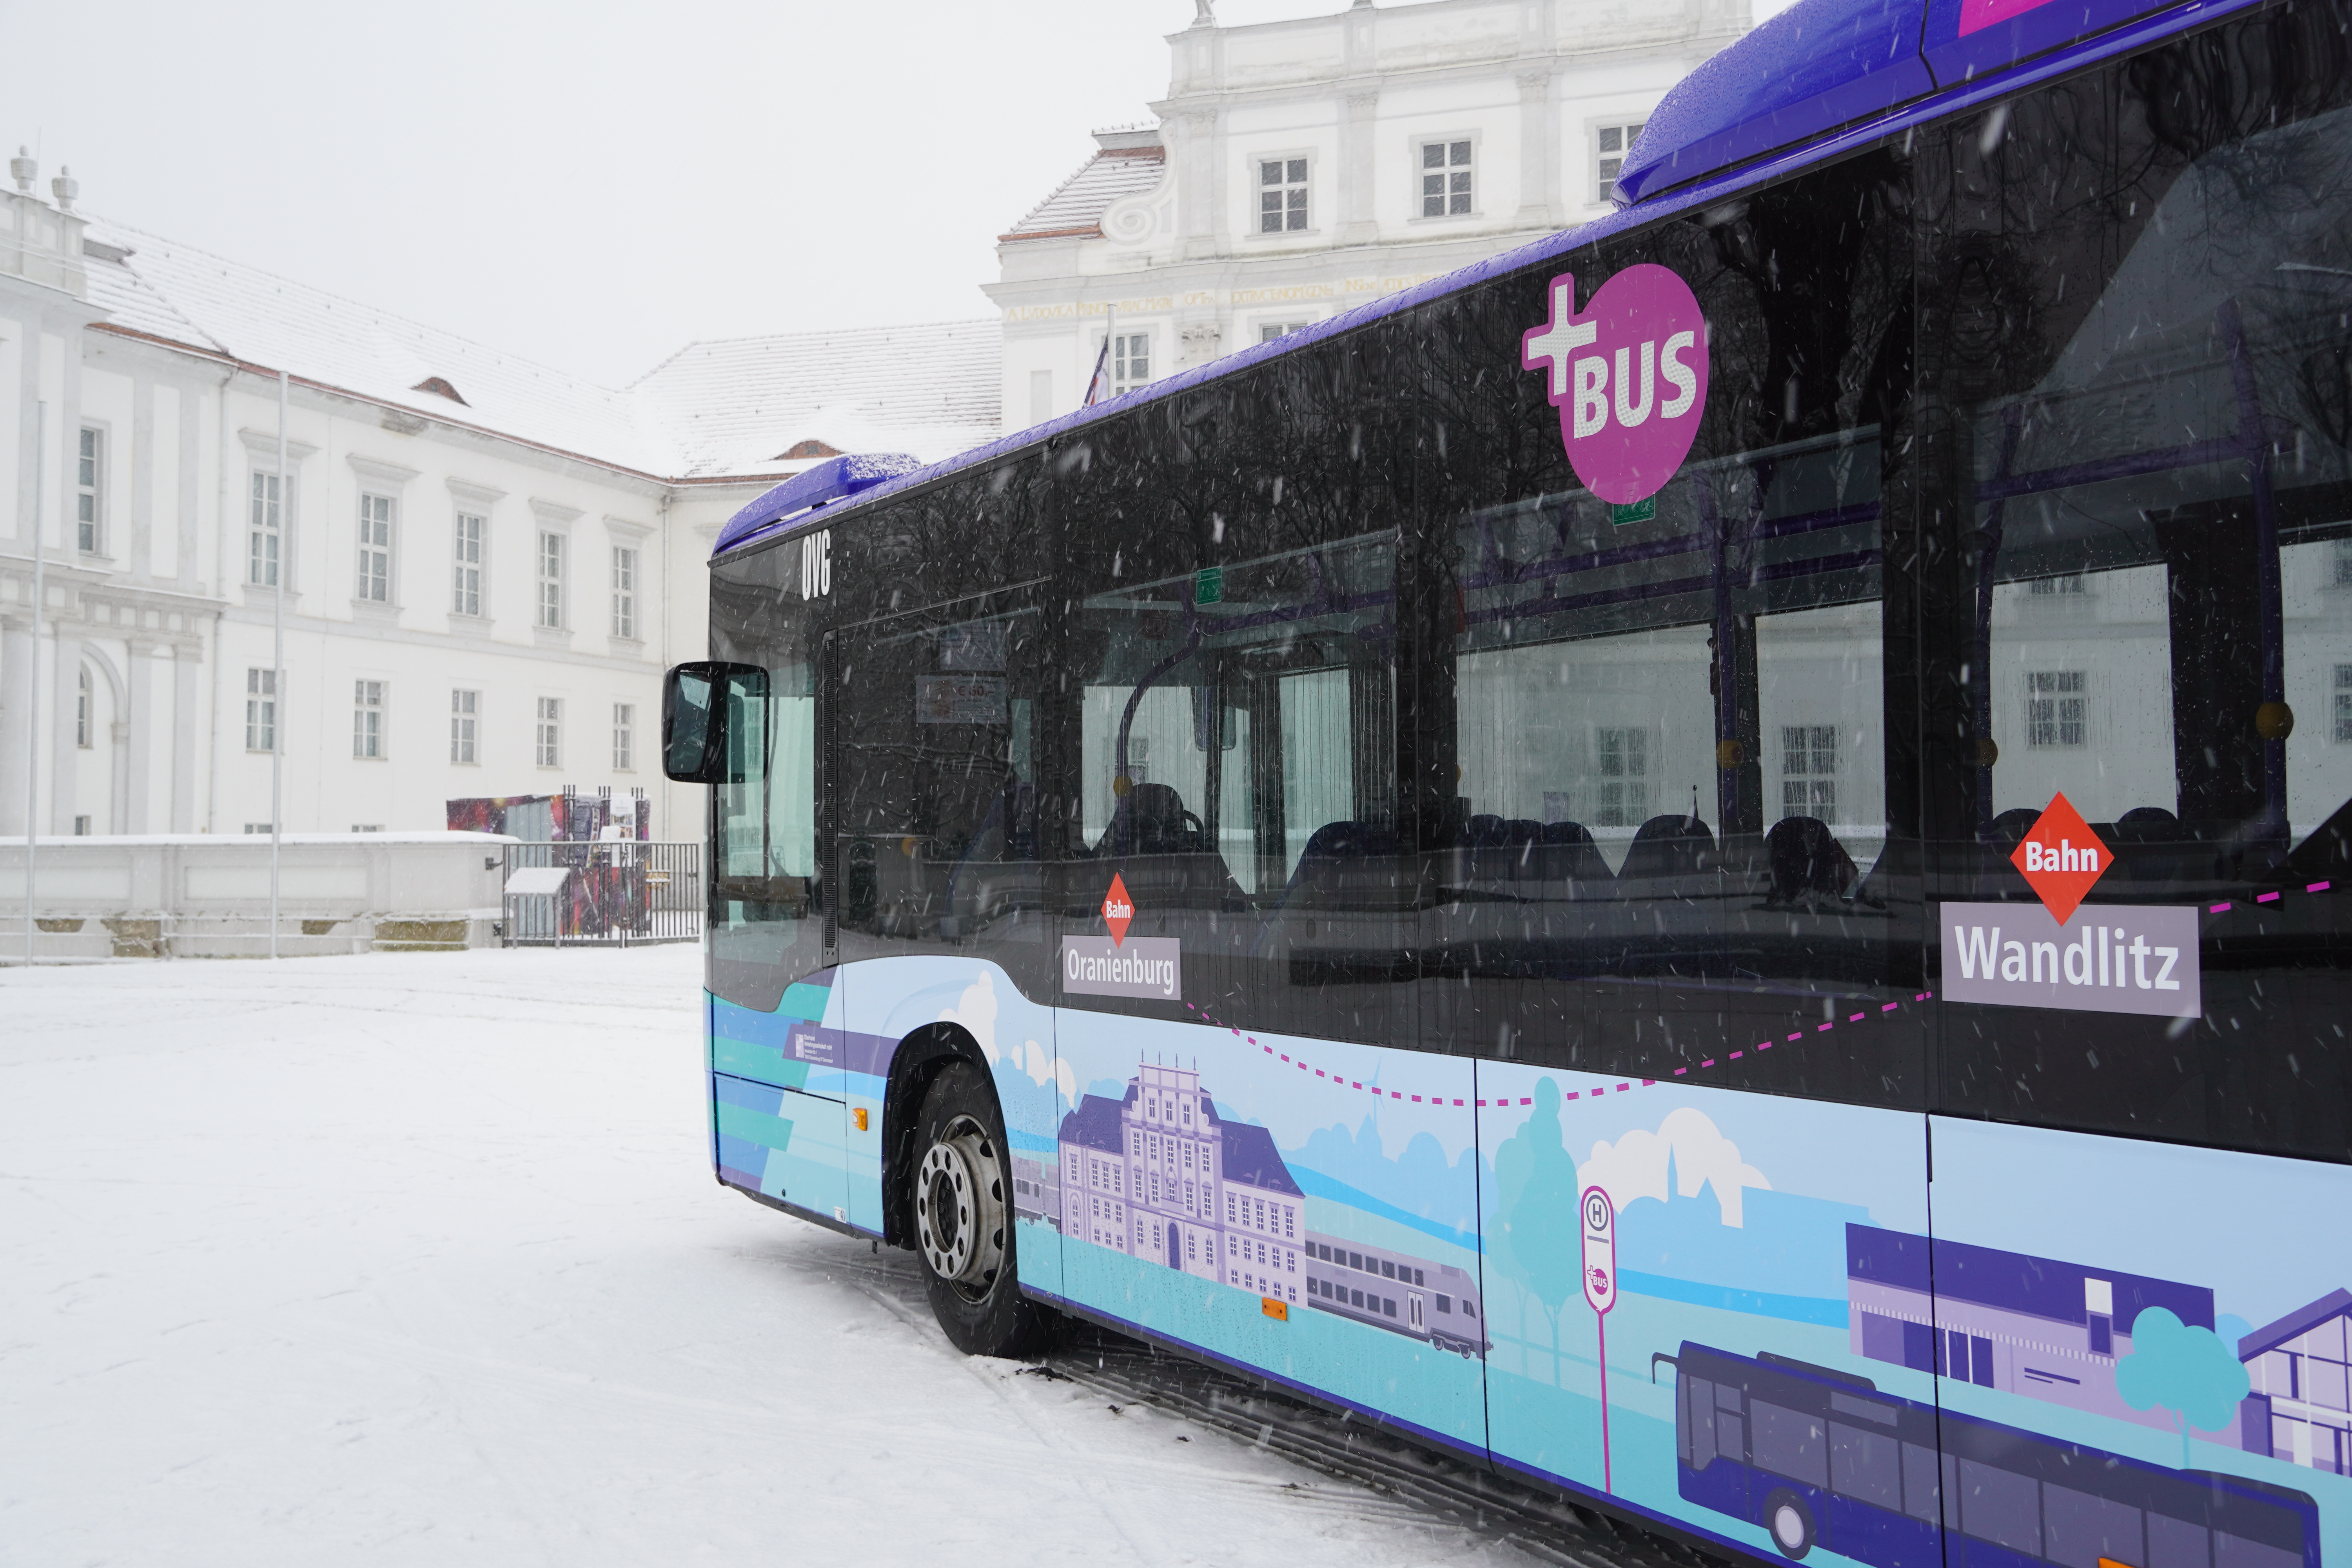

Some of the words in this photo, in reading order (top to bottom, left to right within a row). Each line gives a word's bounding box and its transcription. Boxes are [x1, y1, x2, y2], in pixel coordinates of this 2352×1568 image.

[802, 528, 831, 601] OVG
[2025, 839, 2098, 873] Bahn
[1105, 899, 1131, 919] Bahn
[1067, 948, 1174, 996] Oranienburg
[1954, 925, 2180, 991] Wandlitz
[1592, 1203, 1602, 1223] H
